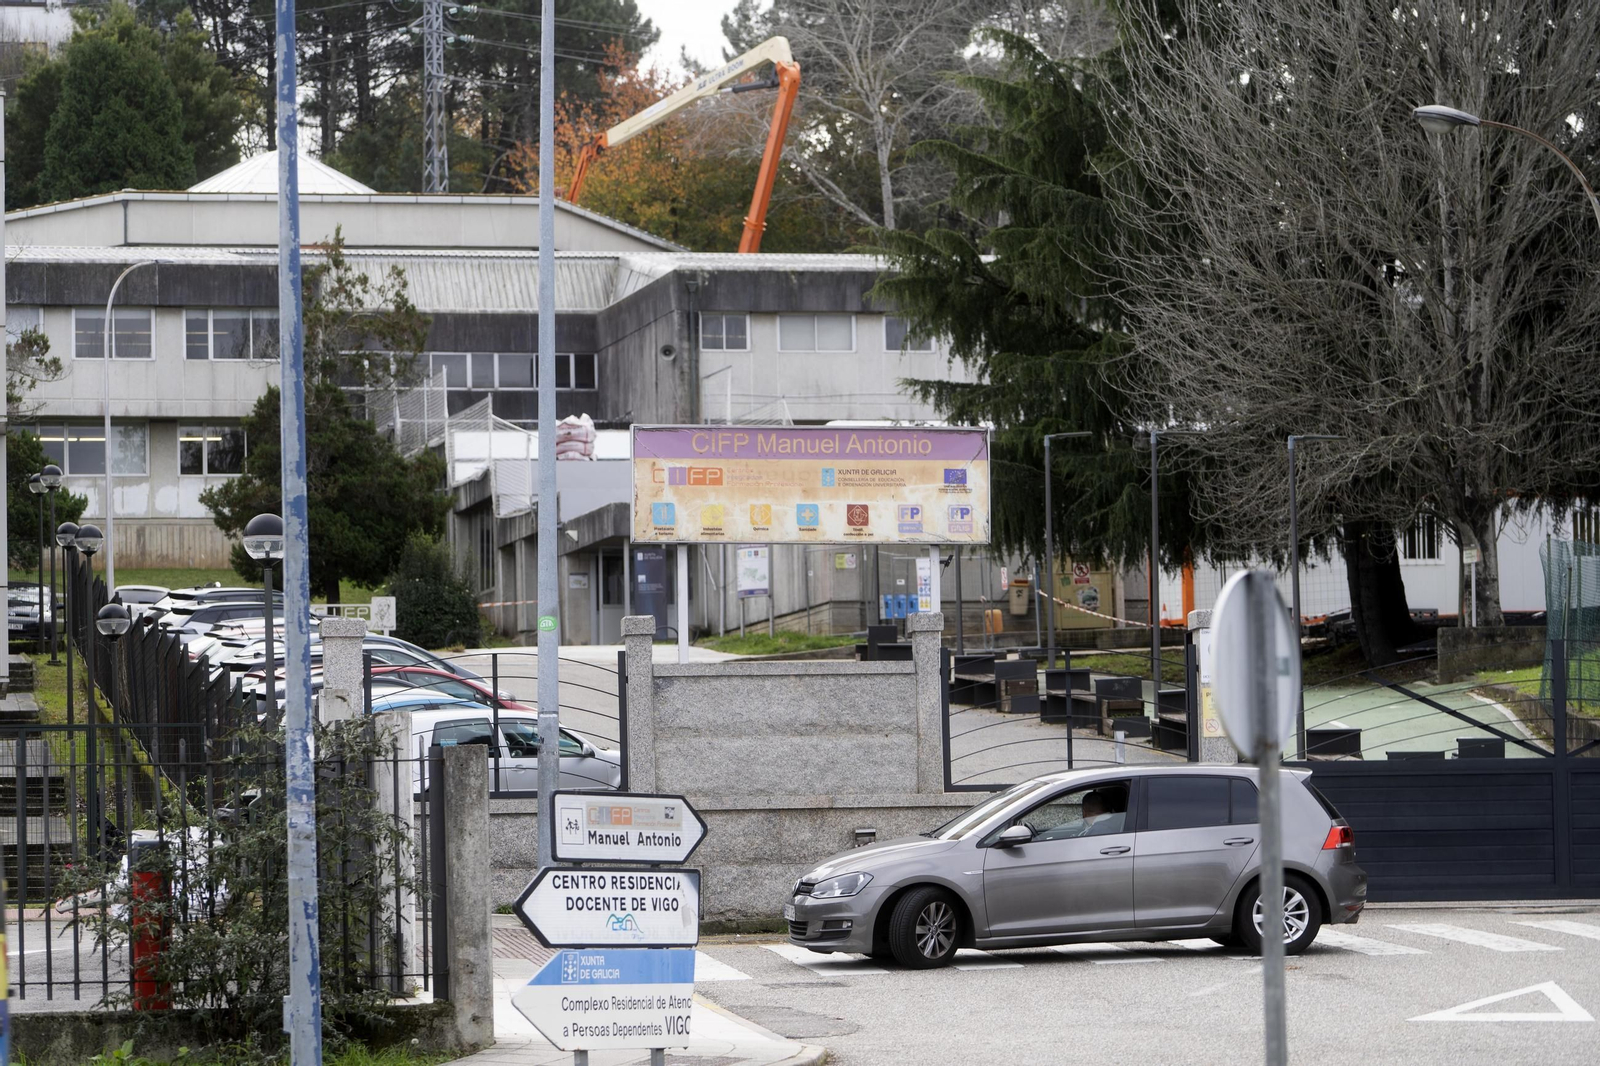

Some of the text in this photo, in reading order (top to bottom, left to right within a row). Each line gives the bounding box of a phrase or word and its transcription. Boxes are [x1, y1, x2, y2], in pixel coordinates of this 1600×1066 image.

[691, 432, 932, 454] CIFP Manuel Antonio
[871, 468, 897, 476] GALICIA
[901, 507, 920, 519] FP
[951, 507, 970, 519] FP
[588, 806, 631, 824] CIFP
[588, 830, 682, 847] Manuel Antonio
[552, 875, 606, 890] CENTRO
[566, 896, 679, 912] DOCENTE DE VIGO
[580, 955, 605, 966] XUNTA
[580, 968, 620, 979] DE GALICIA
[561, 995, 692, 1014] Complexo Residencial de Atenc
[563, 1026, 569, 1037] a
[572, 1023, 610, 1037] Persoas
[612, 1022, 663, 1039] Dependentes
